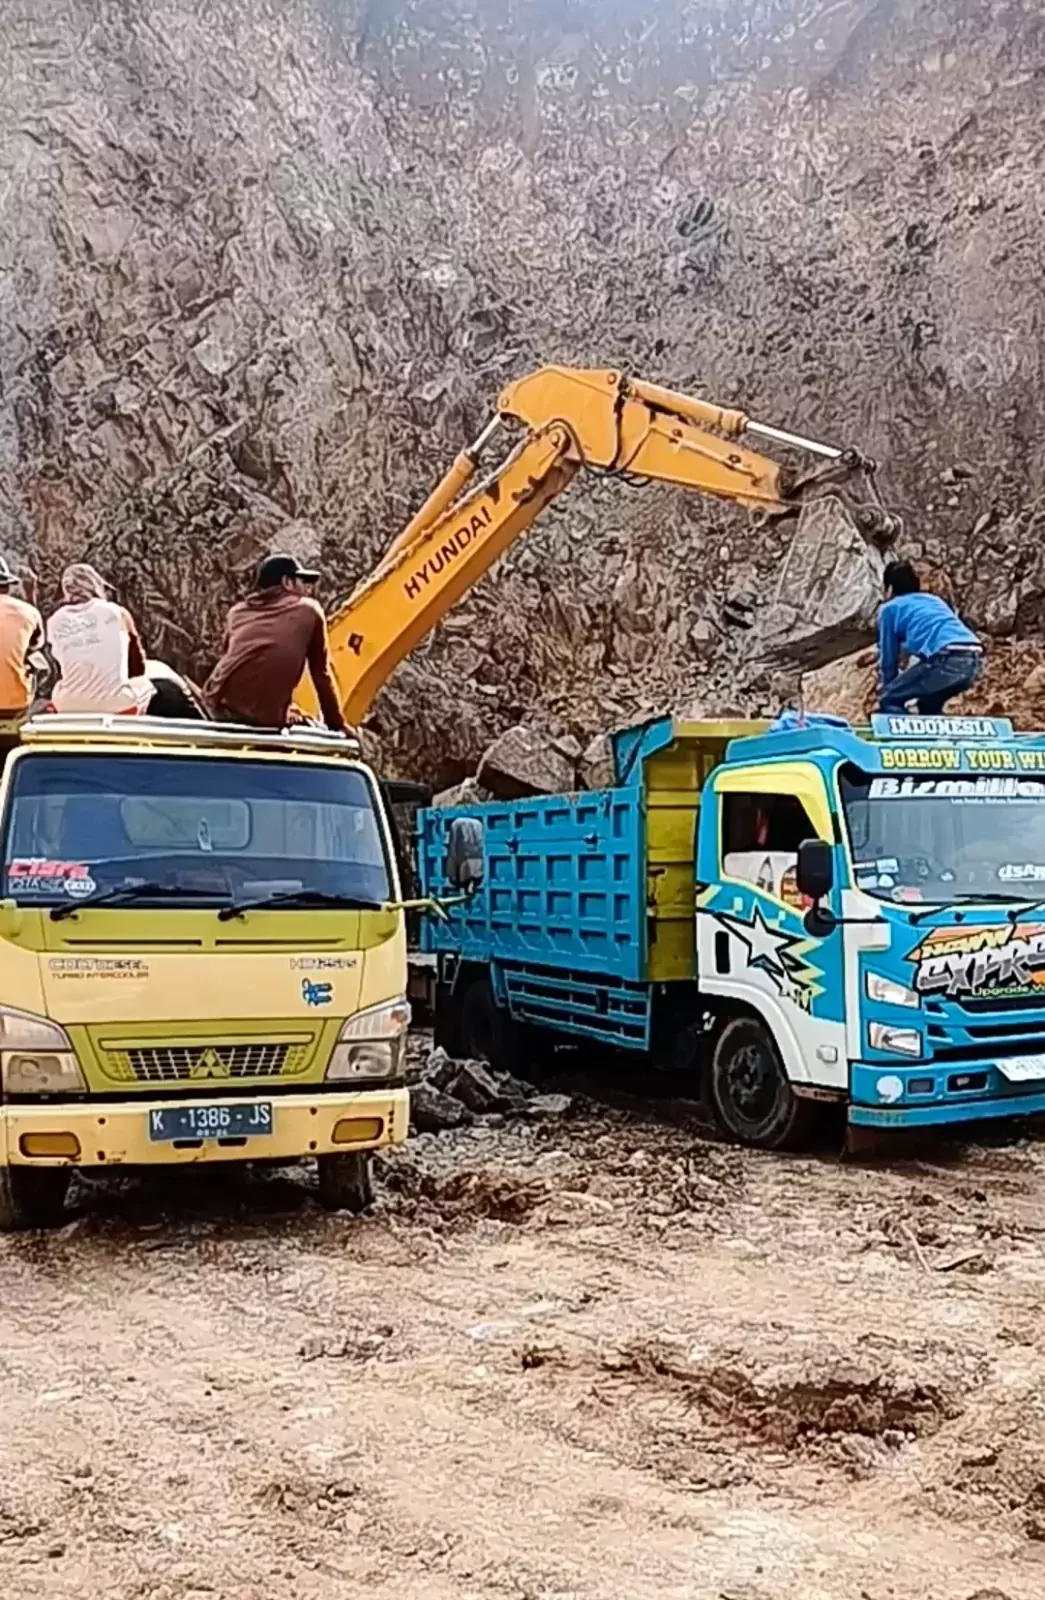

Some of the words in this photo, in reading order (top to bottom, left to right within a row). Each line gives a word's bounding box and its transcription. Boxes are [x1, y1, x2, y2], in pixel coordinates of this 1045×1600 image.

[403, 506, 492, 600] HYUNDAI
[889, 717, 996, 736] INDONESIA
[881, 748, 961, 769] BORROW
[964, 749, 1016, 770] YOUR
[1017, 750, 1045, 770] WI
[972, 984, 1029, 996] Upgrade
[152, 1111, 164, 1131] K
[188, 1107, 231, 1128] 1386
[249, 1104, 270, 1125] JS
